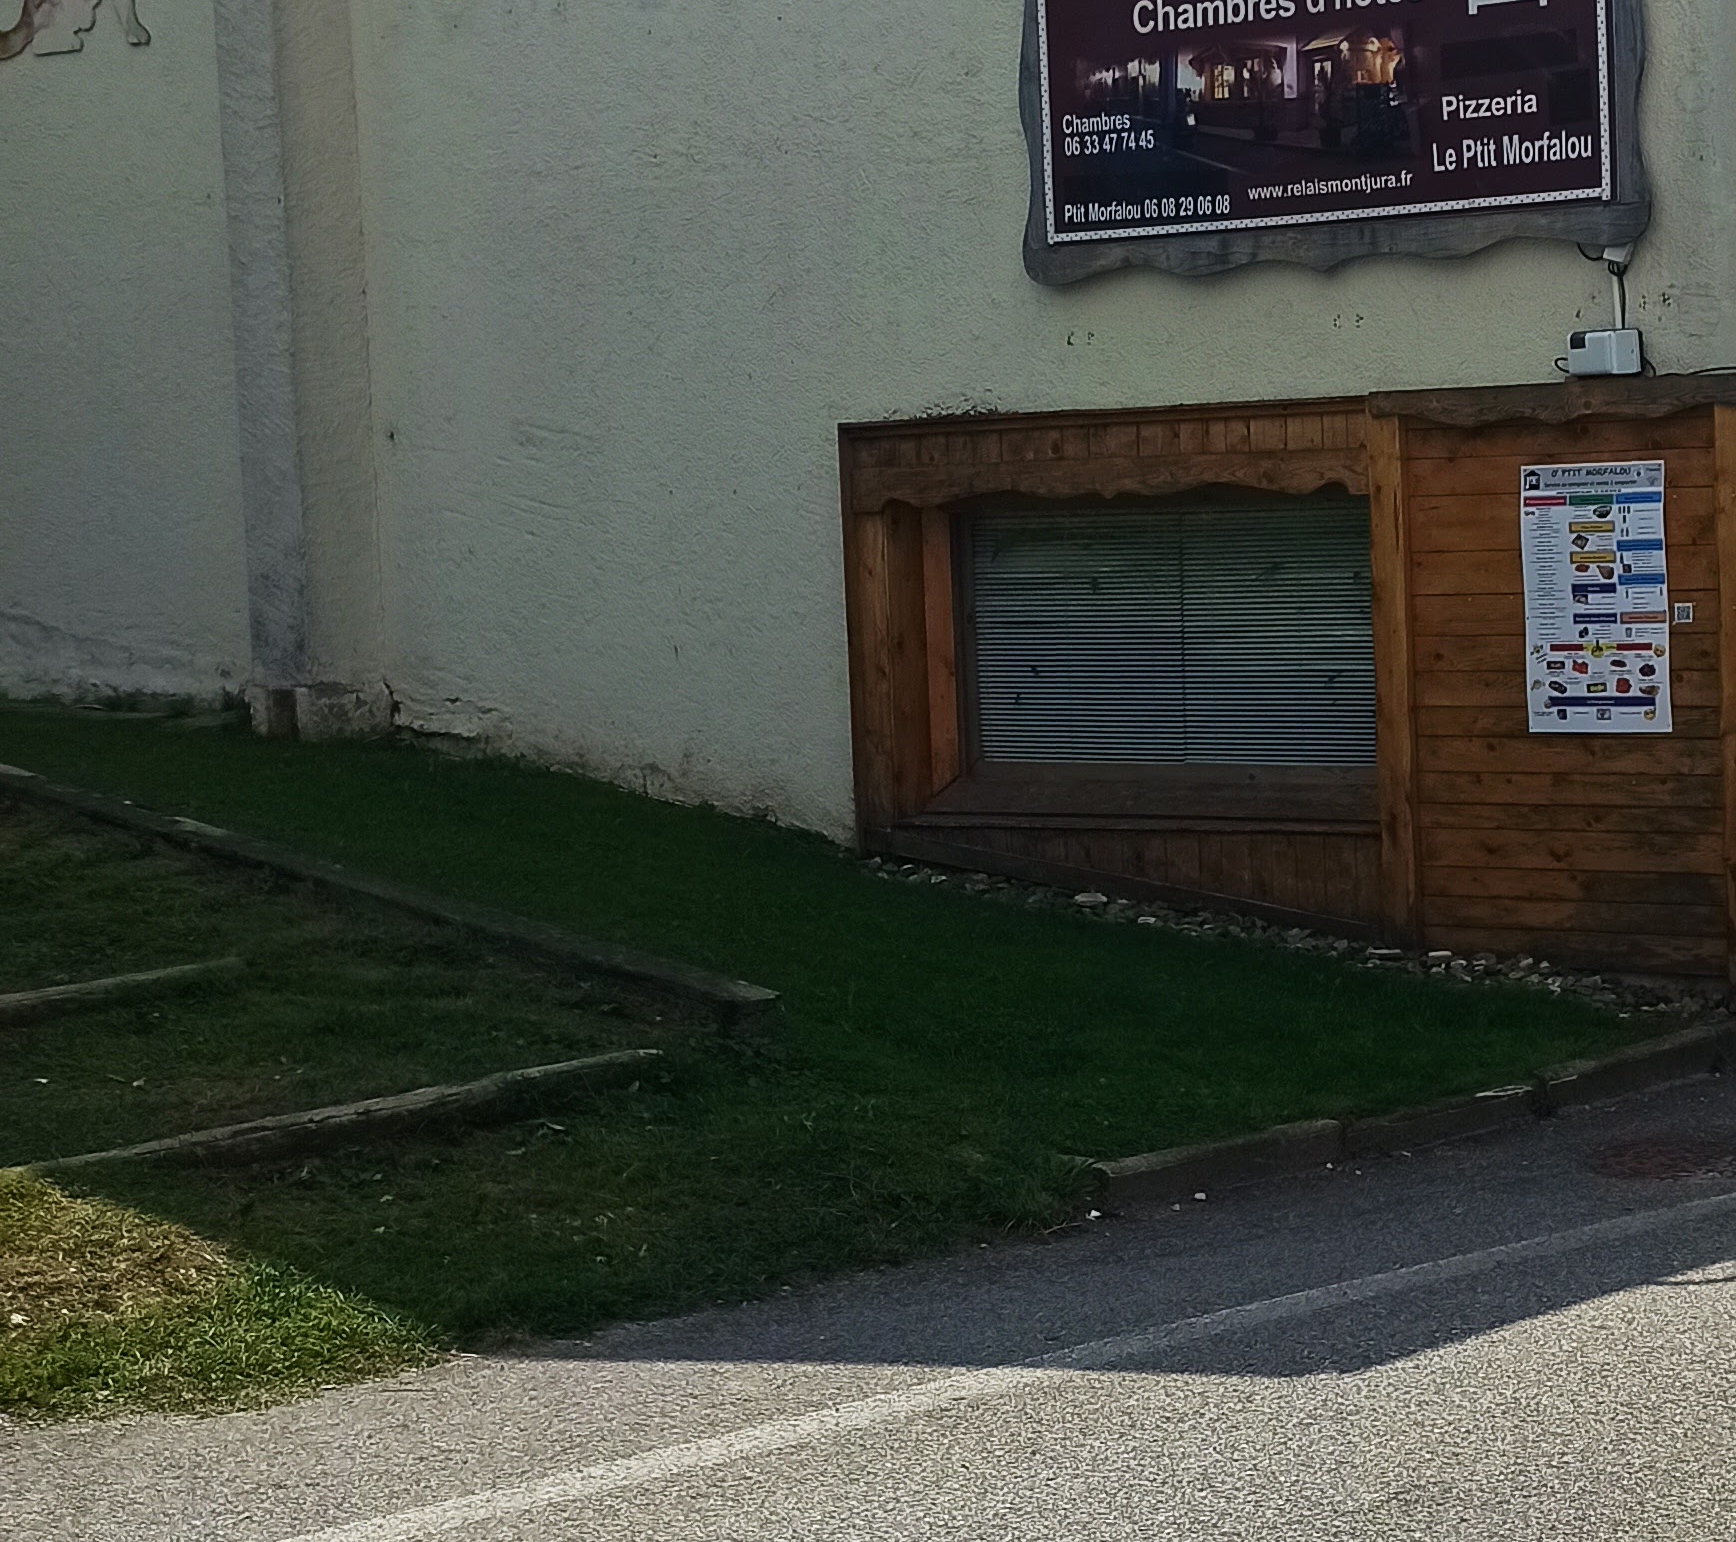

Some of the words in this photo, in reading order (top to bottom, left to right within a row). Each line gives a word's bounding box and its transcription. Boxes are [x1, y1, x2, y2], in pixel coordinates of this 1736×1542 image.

[1441, 89, 1538, 120] Pizzeria
[1062, 112, 1131, 134] Chambres
[1064, 136, 1080, 156] 06
[1084, 135, 1099, 155] 33
[1103, 133, 1118, 153] 47
[1121, 131, 1136, 151] 74
[1139, 130, 1154, 149] 45
[1432, 143, 1457, 172] Le
[1462, 135, 1497, 169] Ptit
[1502, 129, 1593, 165] Morfalou
[1247, 170, 1413, 200] www.relaismontjura.fr
[1064, 203, 1085, 223] Ptit
[1088, 201, 1141, 222] Morfalou
[1144, 198, 1158, 218] 06
[1161, 197, 1176, 217] 08
[1179, 196, 1194, 216] 29
[1197, 195, 1212, 215] 06
[1215, 194, 1230, 214] 08
[1585, 466, 1631, 476] MORFALOU
